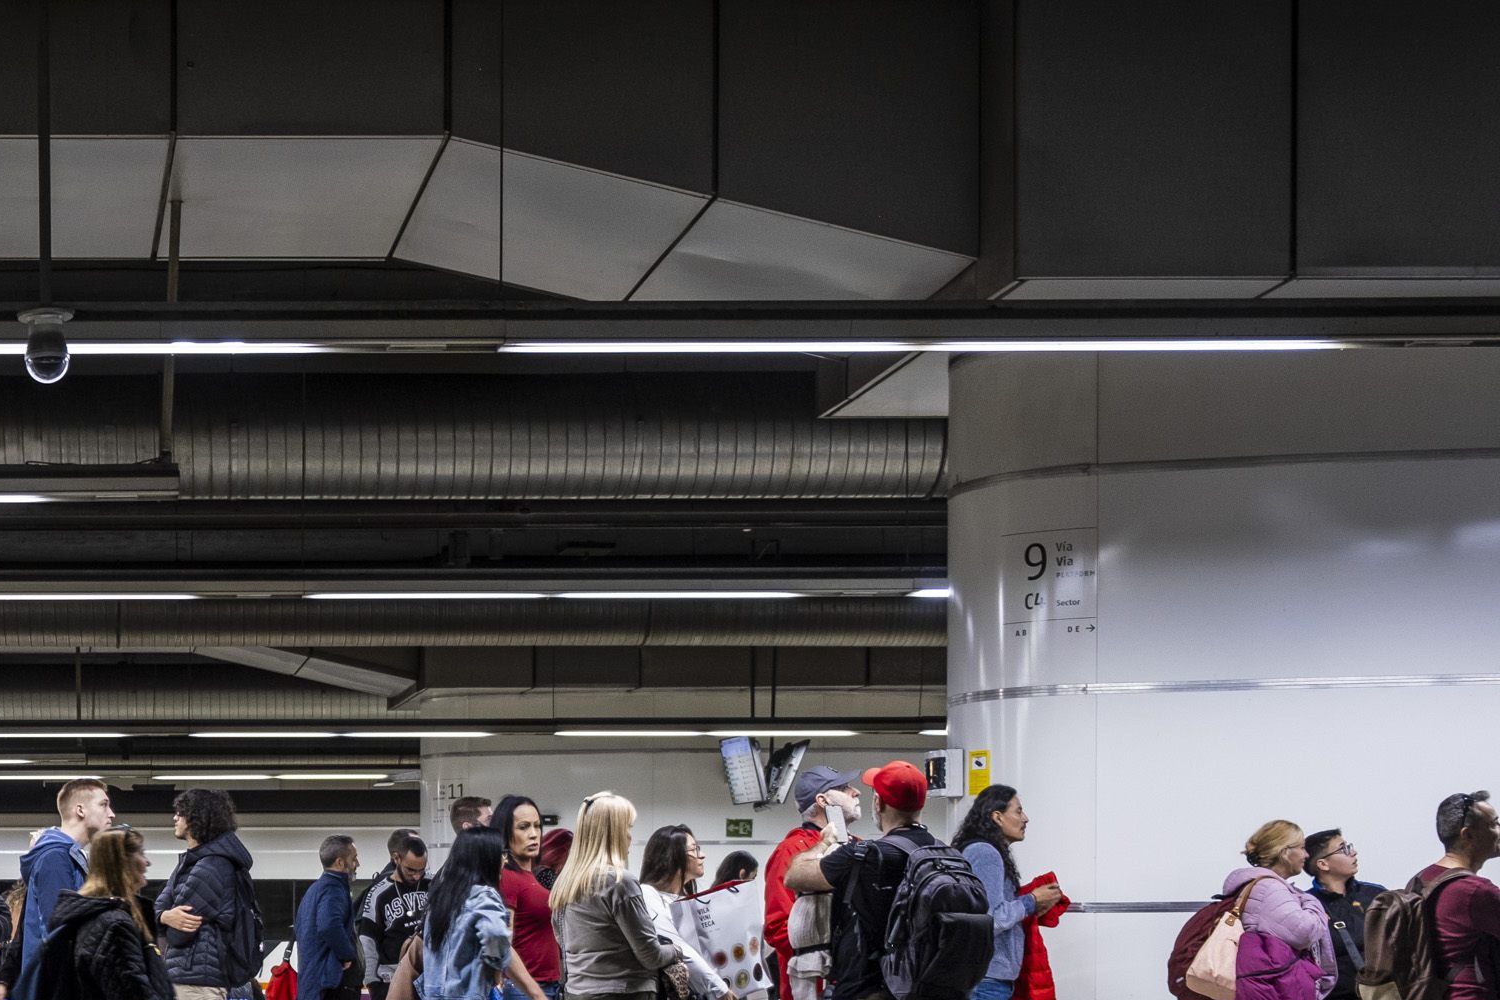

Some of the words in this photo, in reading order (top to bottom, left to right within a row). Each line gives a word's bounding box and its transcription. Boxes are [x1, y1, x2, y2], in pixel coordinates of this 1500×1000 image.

[1025, 543, 1047, 581] 9
[1056, 556, 1074, 567] Via
[1025, 593, 1046, 610] C4
[448, 783, 464, 799] 11
[701, 920, 715, 928] TECA
